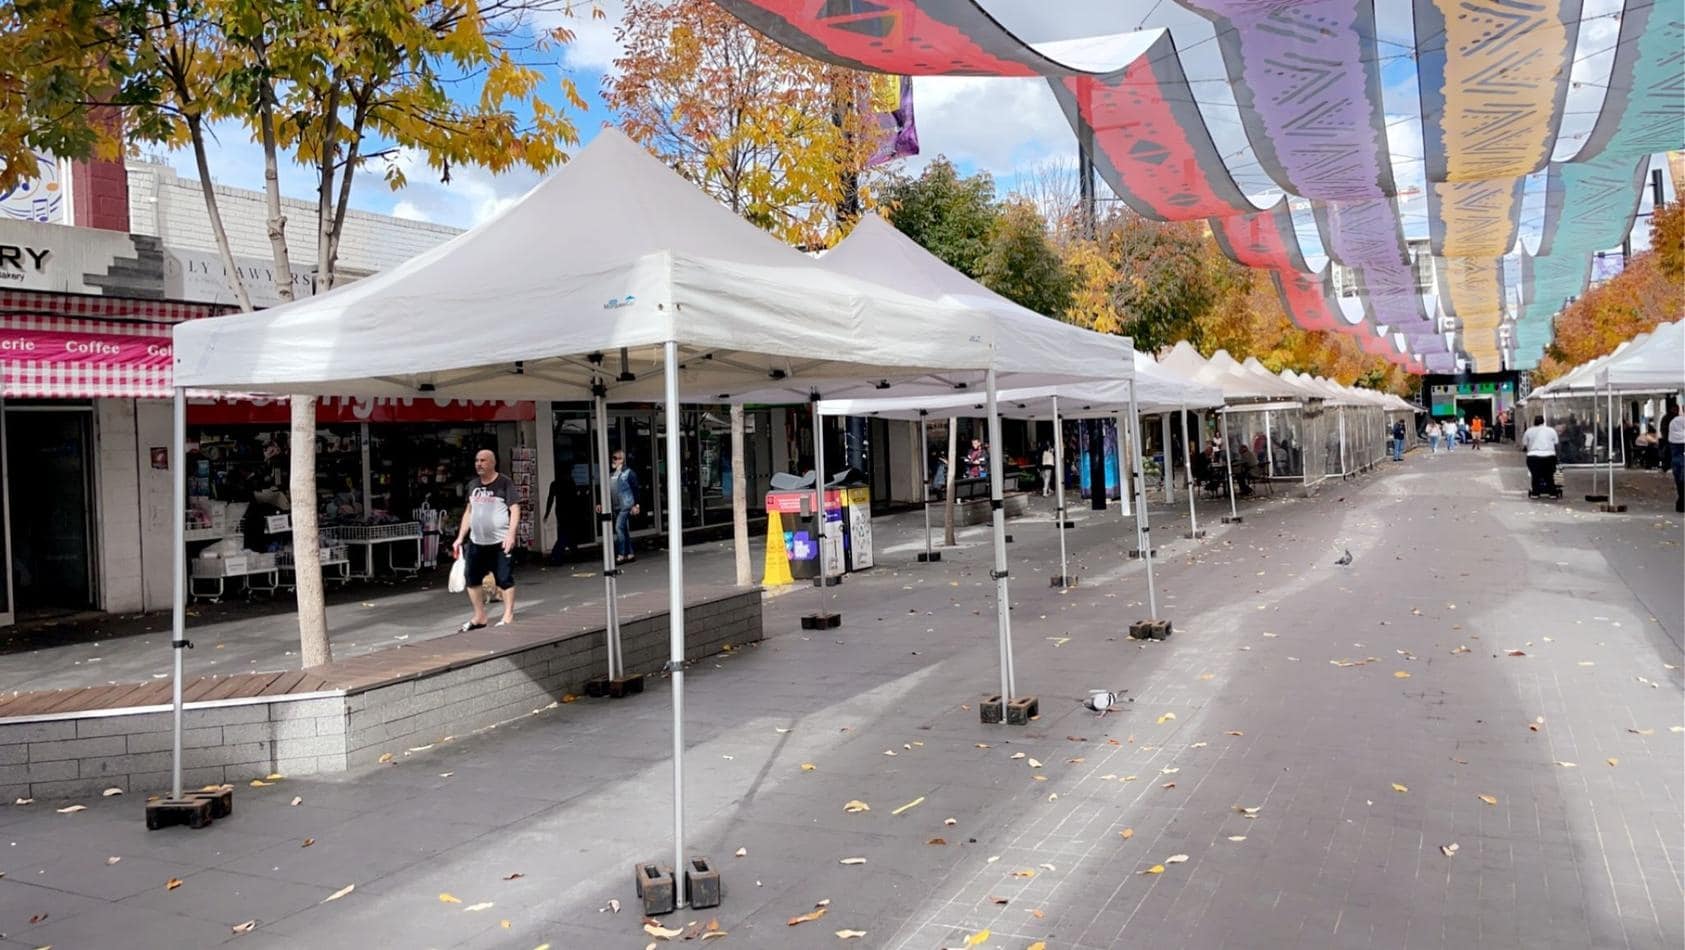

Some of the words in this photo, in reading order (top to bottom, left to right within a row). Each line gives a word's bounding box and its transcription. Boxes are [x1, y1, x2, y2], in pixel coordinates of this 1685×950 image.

[189, 260, 210, 275] LY
[223, 265, 311, 286] LAWYRS
[65, 341, 120, 354] Coffee
